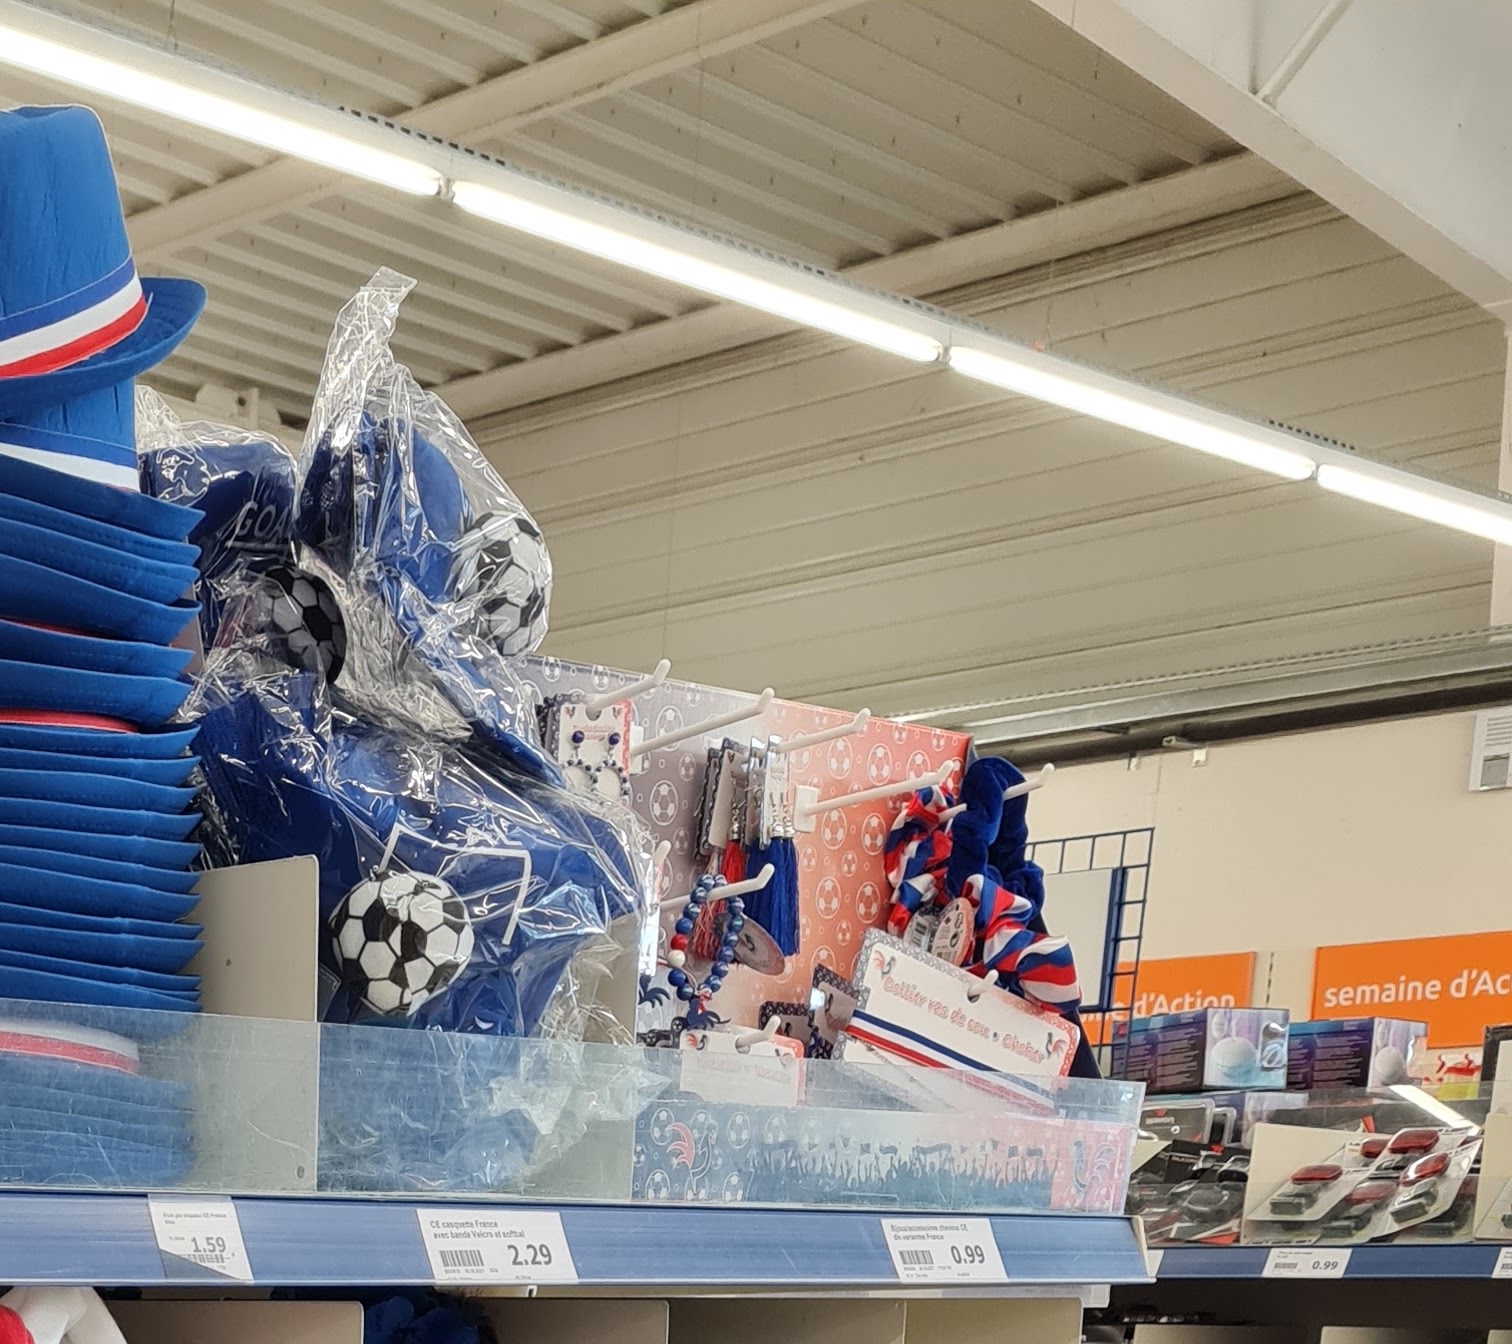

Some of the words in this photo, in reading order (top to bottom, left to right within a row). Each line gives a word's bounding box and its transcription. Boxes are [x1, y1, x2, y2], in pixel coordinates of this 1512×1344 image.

[237, 500, 289, 540] GOA
[1324, 973, 1441, 1009] semaine
[1133, 988, 1236, 1018] d'Action
[191, 1236, 226, 1253] 1.59
[507, 1244, 552, 1267] 2.29
[950, 1245, 985, 1265] 0.99
[1312, 1259, 1339, 1272] 0.99
